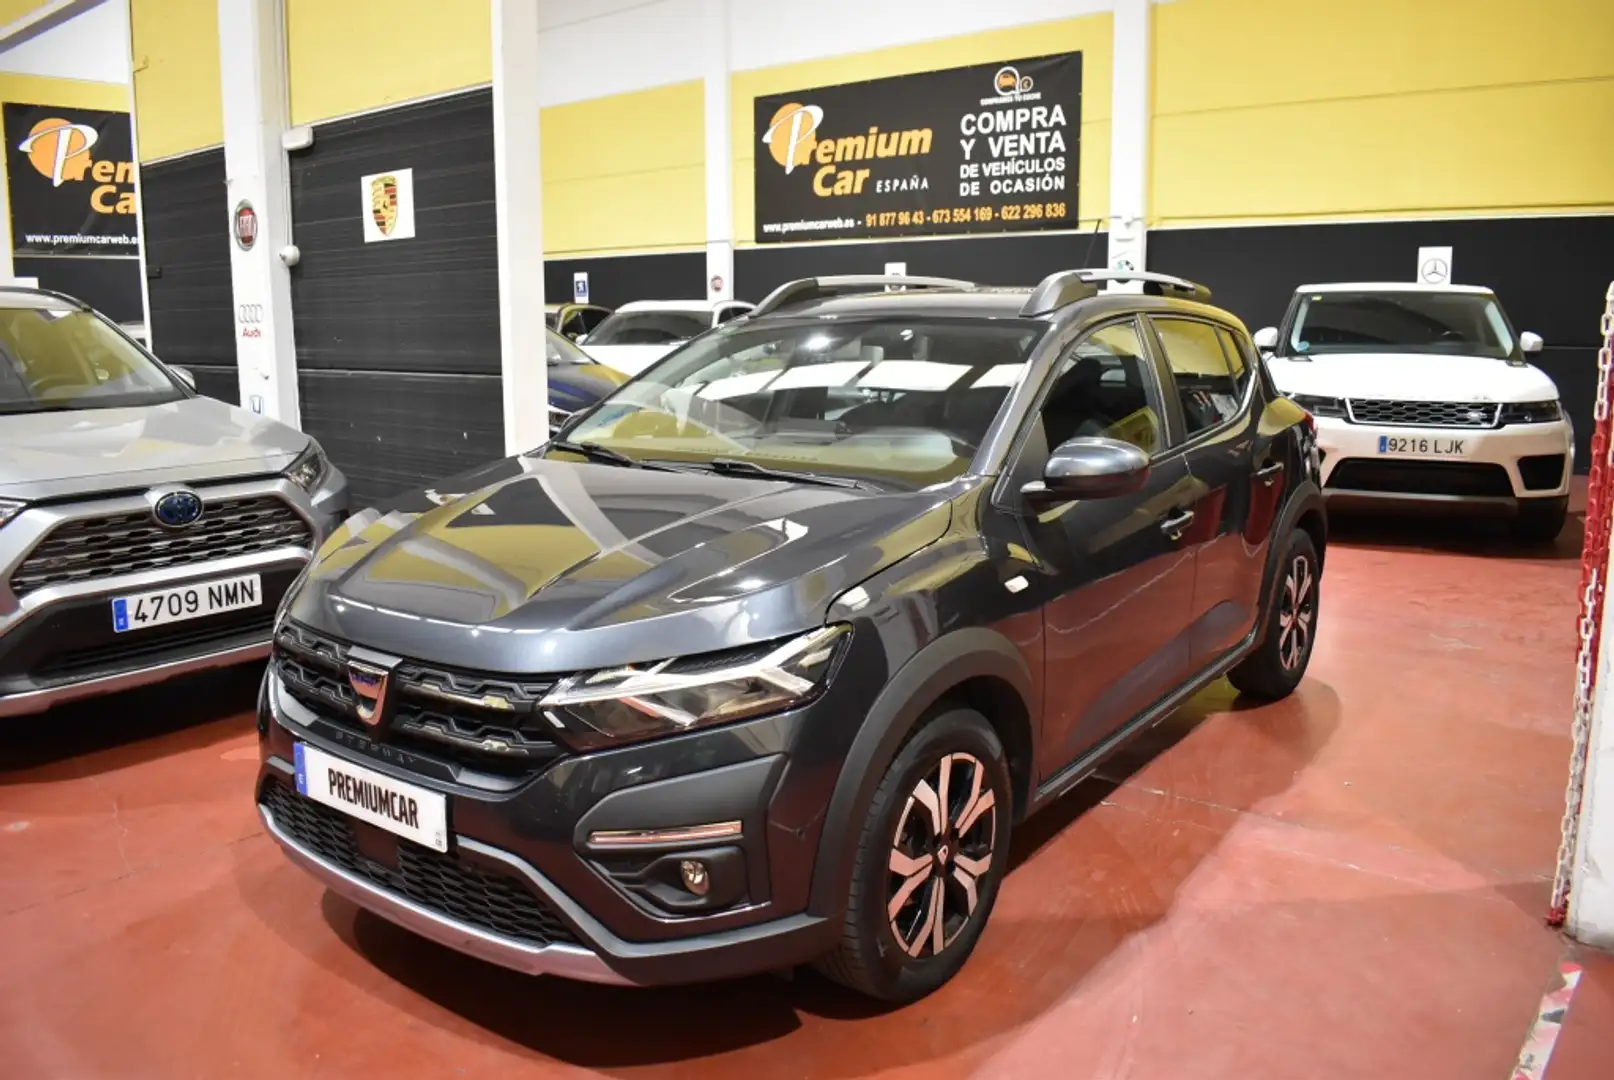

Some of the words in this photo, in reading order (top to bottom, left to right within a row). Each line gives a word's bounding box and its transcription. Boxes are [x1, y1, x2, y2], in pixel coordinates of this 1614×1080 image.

[960, 104, 1067, 136] COMPRA
[762, 104, 933, 175] Premium
[960, 138, 976, 160] Y
[988, 130, 1066, 158] VENTA
[813, 165, 870, 197] Car
[876, 174, 929, 194] ESPAÑA
[960, 164, 980, 179] DE
[982, 156, 1066, 177] VEHÍCULOS
[960, 181, 980, 197] DE
[990, 173, 1065, 195] OCASIÓN
[865, 213, 877, 227] 91
[879, 212, 897, 226] 877
[898, 211, 910, 226] 96
[912, 210, 925, 225] 43
[932, 209, 950, 224] 673
[953, 208, 971, 223] 554
[974, 206, 992, 221] 169
[1001, 205, 1021, 220] 622
[1023, 204, 1043, 219] 296
[1045, 202, 1066, 217] 836
[243, 326, 261, 338] Audi
[1388, 438, 1428, 453] 9216
[1434, 439, 1464, 454] LJK
[134, 590, 199, 623] 4709
[208, 579, 255, 610] NMN
[327, 767, 419, 829] PREMIUMCAR
